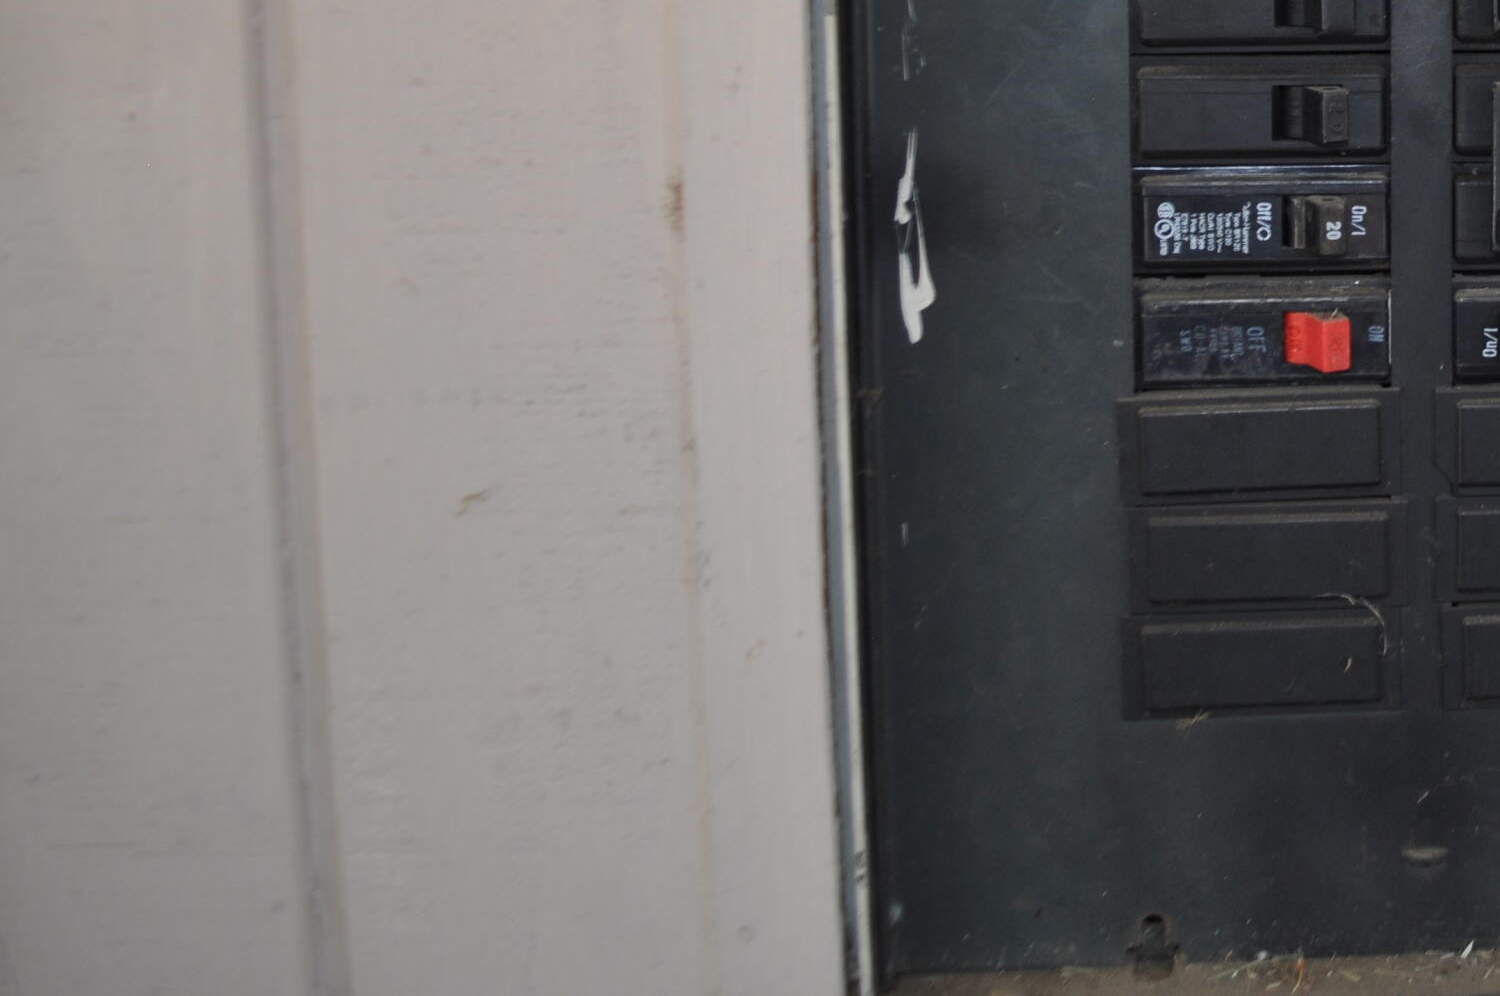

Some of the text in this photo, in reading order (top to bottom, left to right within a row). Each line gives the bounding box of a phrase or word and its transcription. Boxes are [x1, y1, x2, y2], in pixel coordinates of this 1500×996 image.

[1325, 220, 1342, 240] 20
[1247, 326, 1266, 353] OFF
[1367, 325, 1385, 343] ON
